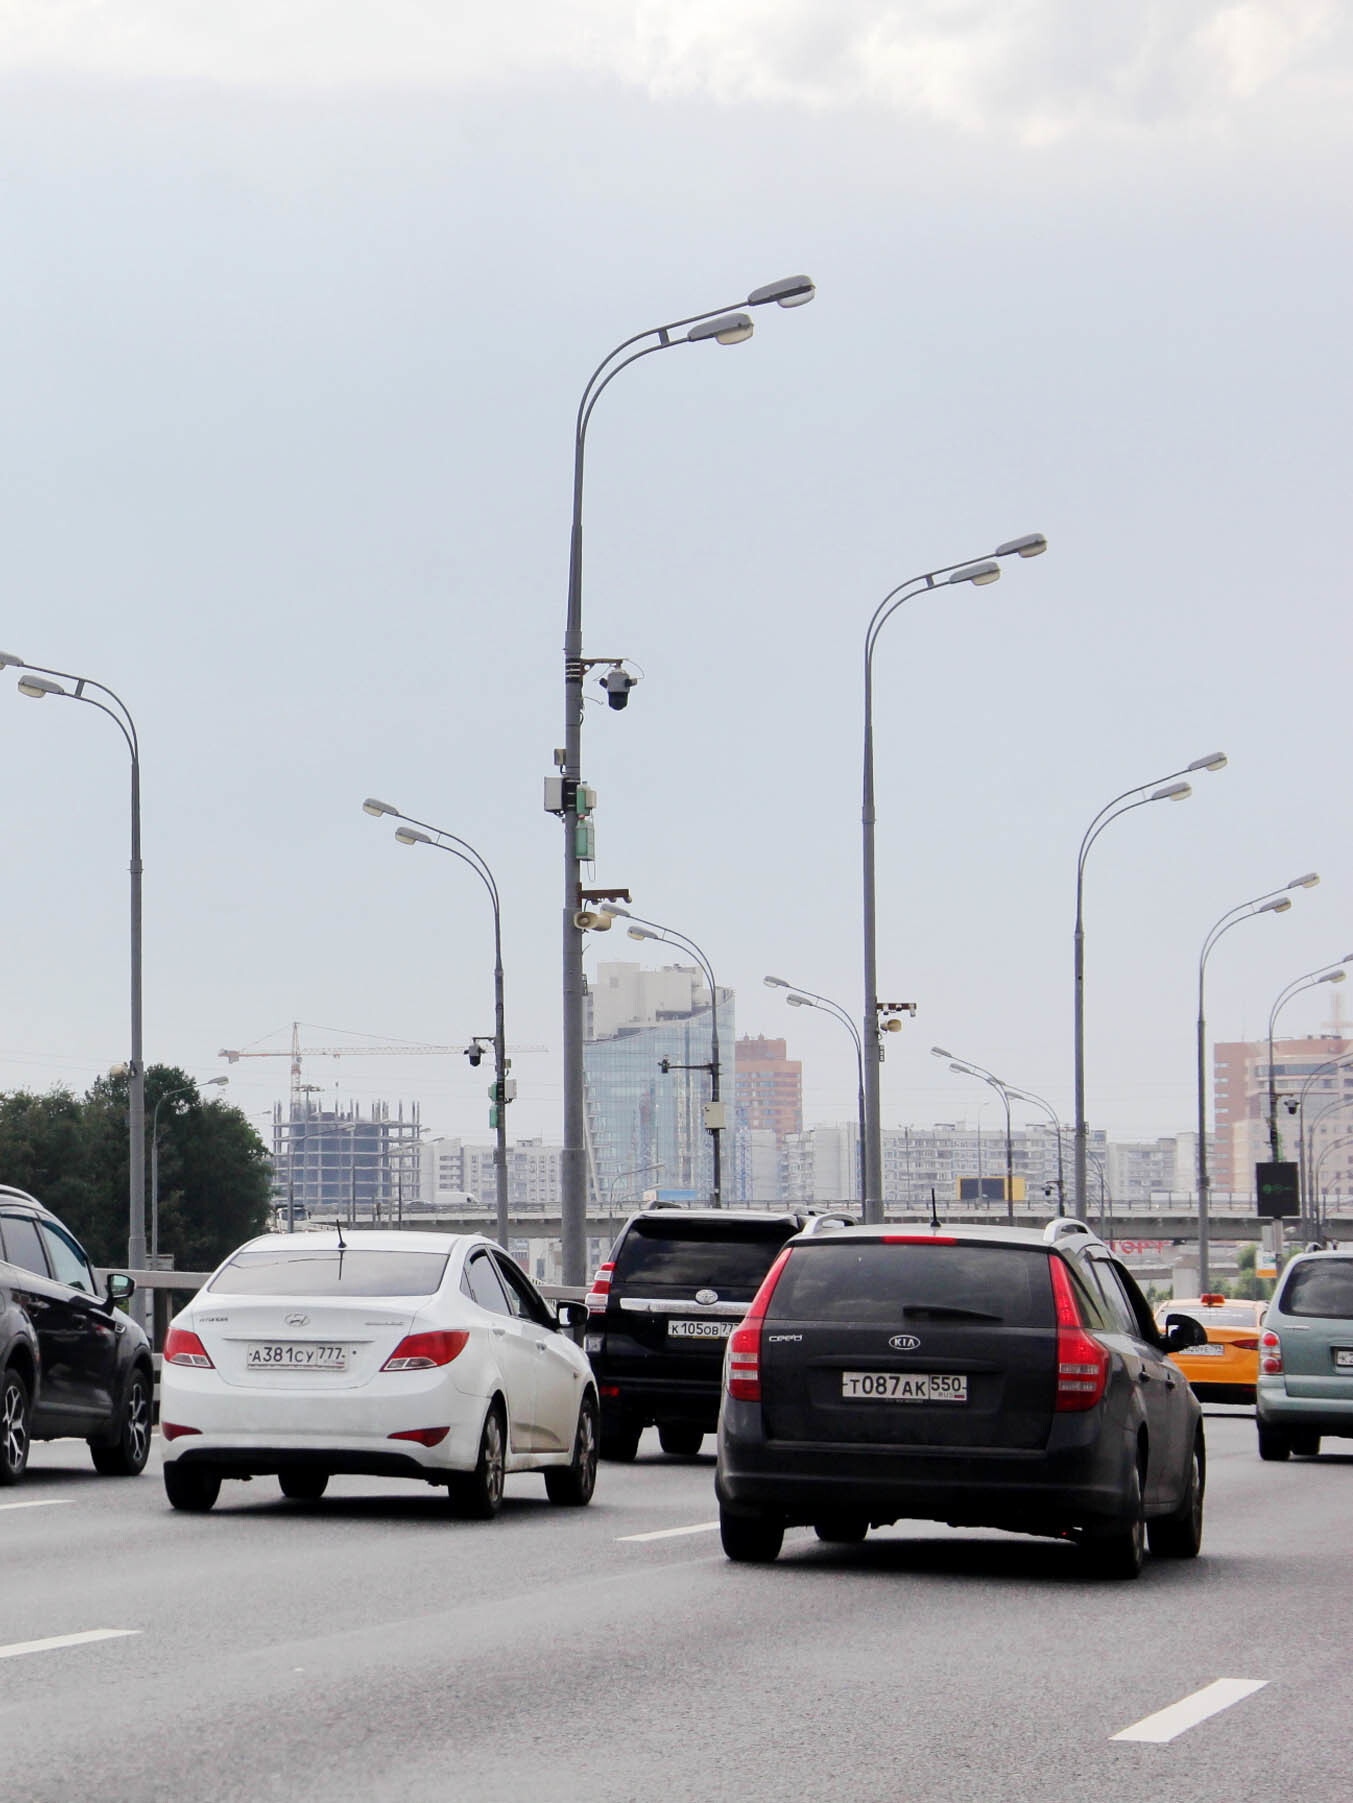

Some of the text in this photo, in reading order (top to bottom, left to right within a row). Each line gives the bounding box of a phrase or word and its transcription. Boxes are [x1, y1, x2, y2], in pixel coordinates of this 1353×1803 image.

[671, 1323, 719, 1336] К105ОВ
[894, 1338, 915, 1347] KIA
[252, 1347, 342, 1363] А381СУ 777
[850, 1376, 961, 1397] Т087АК 550
